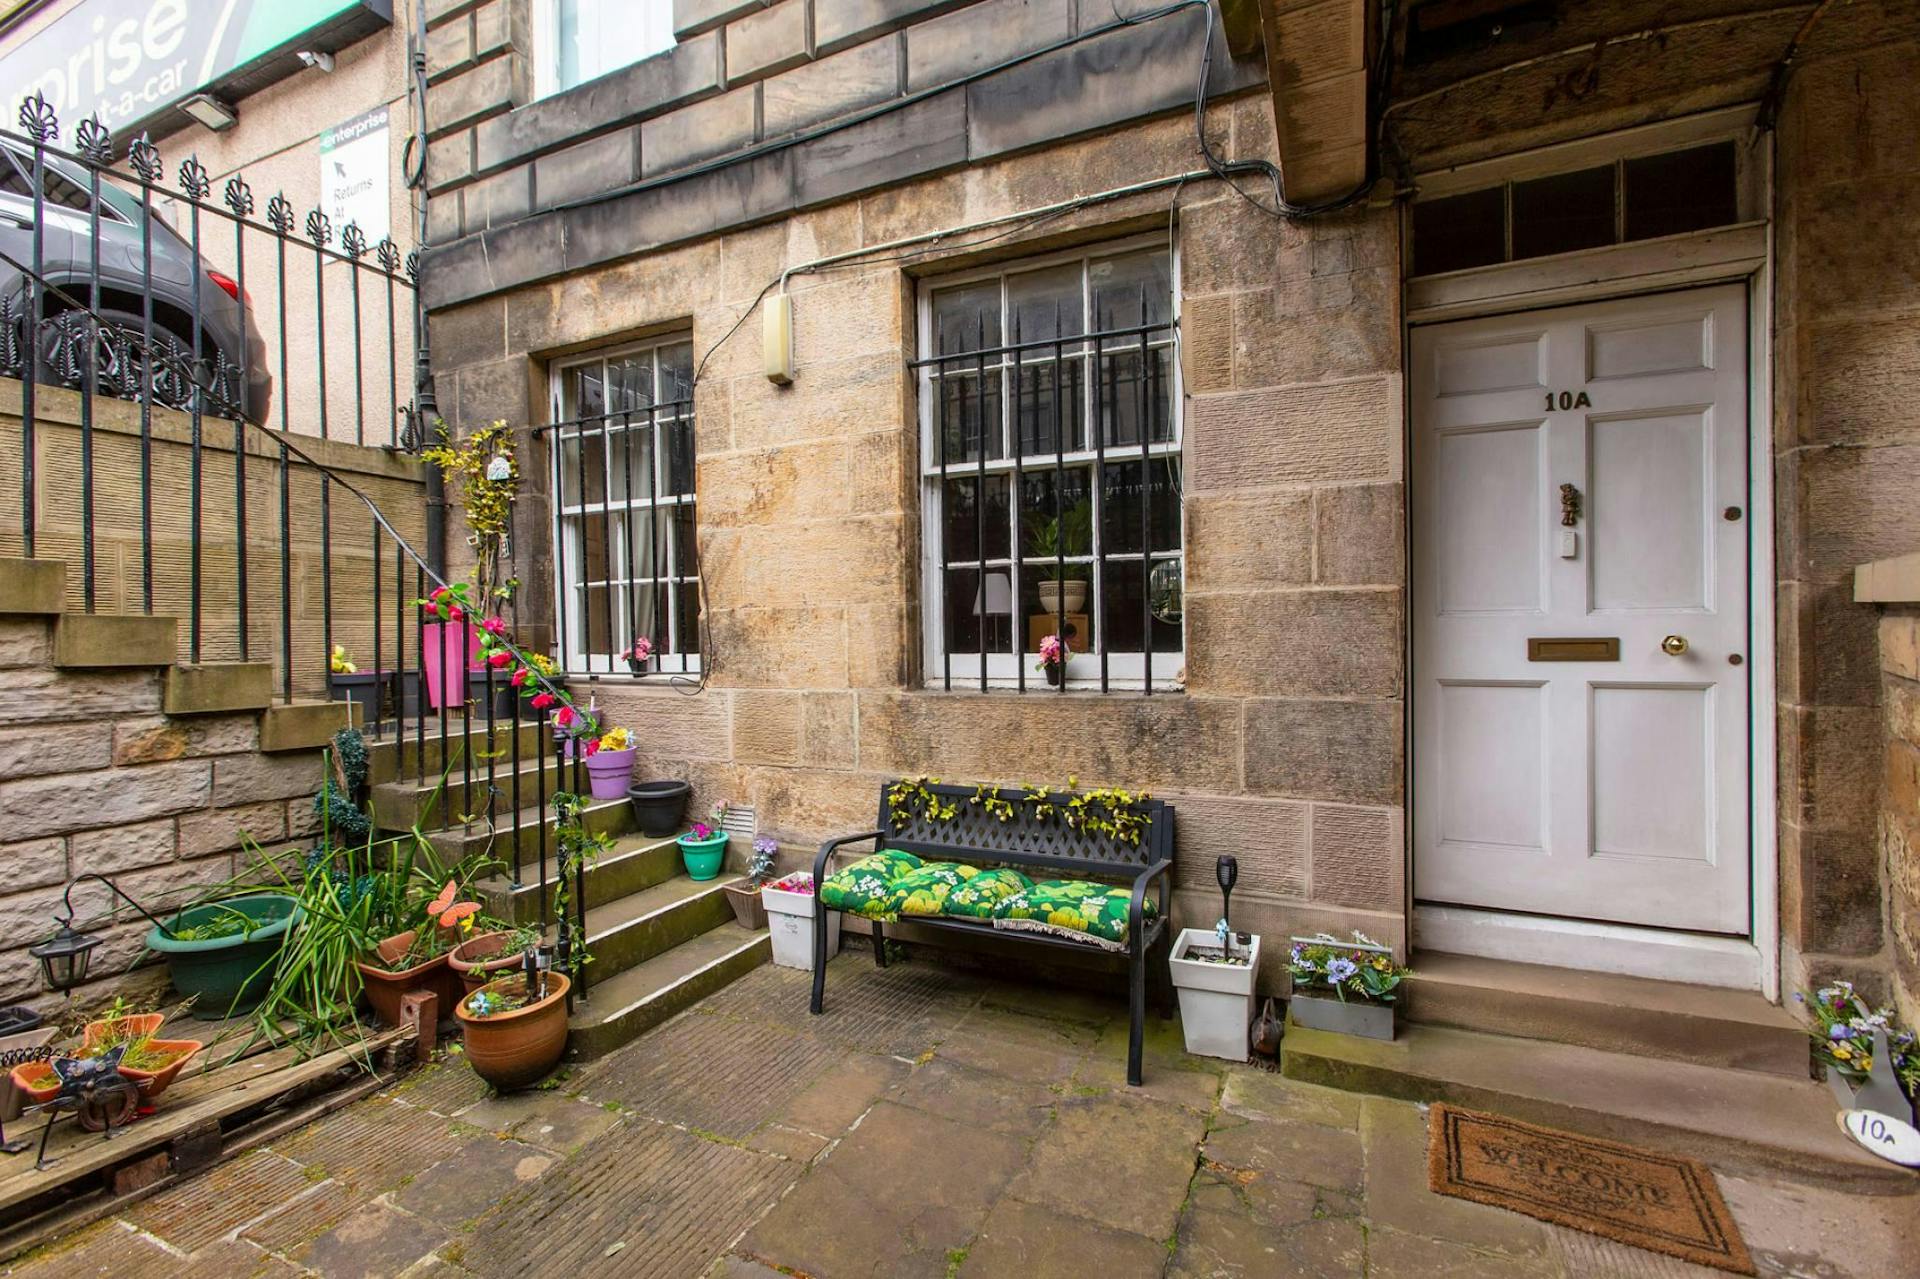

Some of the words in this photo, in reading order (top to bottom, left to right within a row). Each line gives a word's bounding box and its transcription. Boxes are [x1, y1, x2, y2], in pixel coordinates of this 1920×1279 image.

[0, 0, 188, 131] prise
[323, 112, 387, 145] enterprise
[334, 178, 373, 201] Returns
[1545, 391, 1592, 412] 10A
[1861, 1114, 1896, 1145] 10A
[1478, 1140, 1670, 1204] WELCOME
